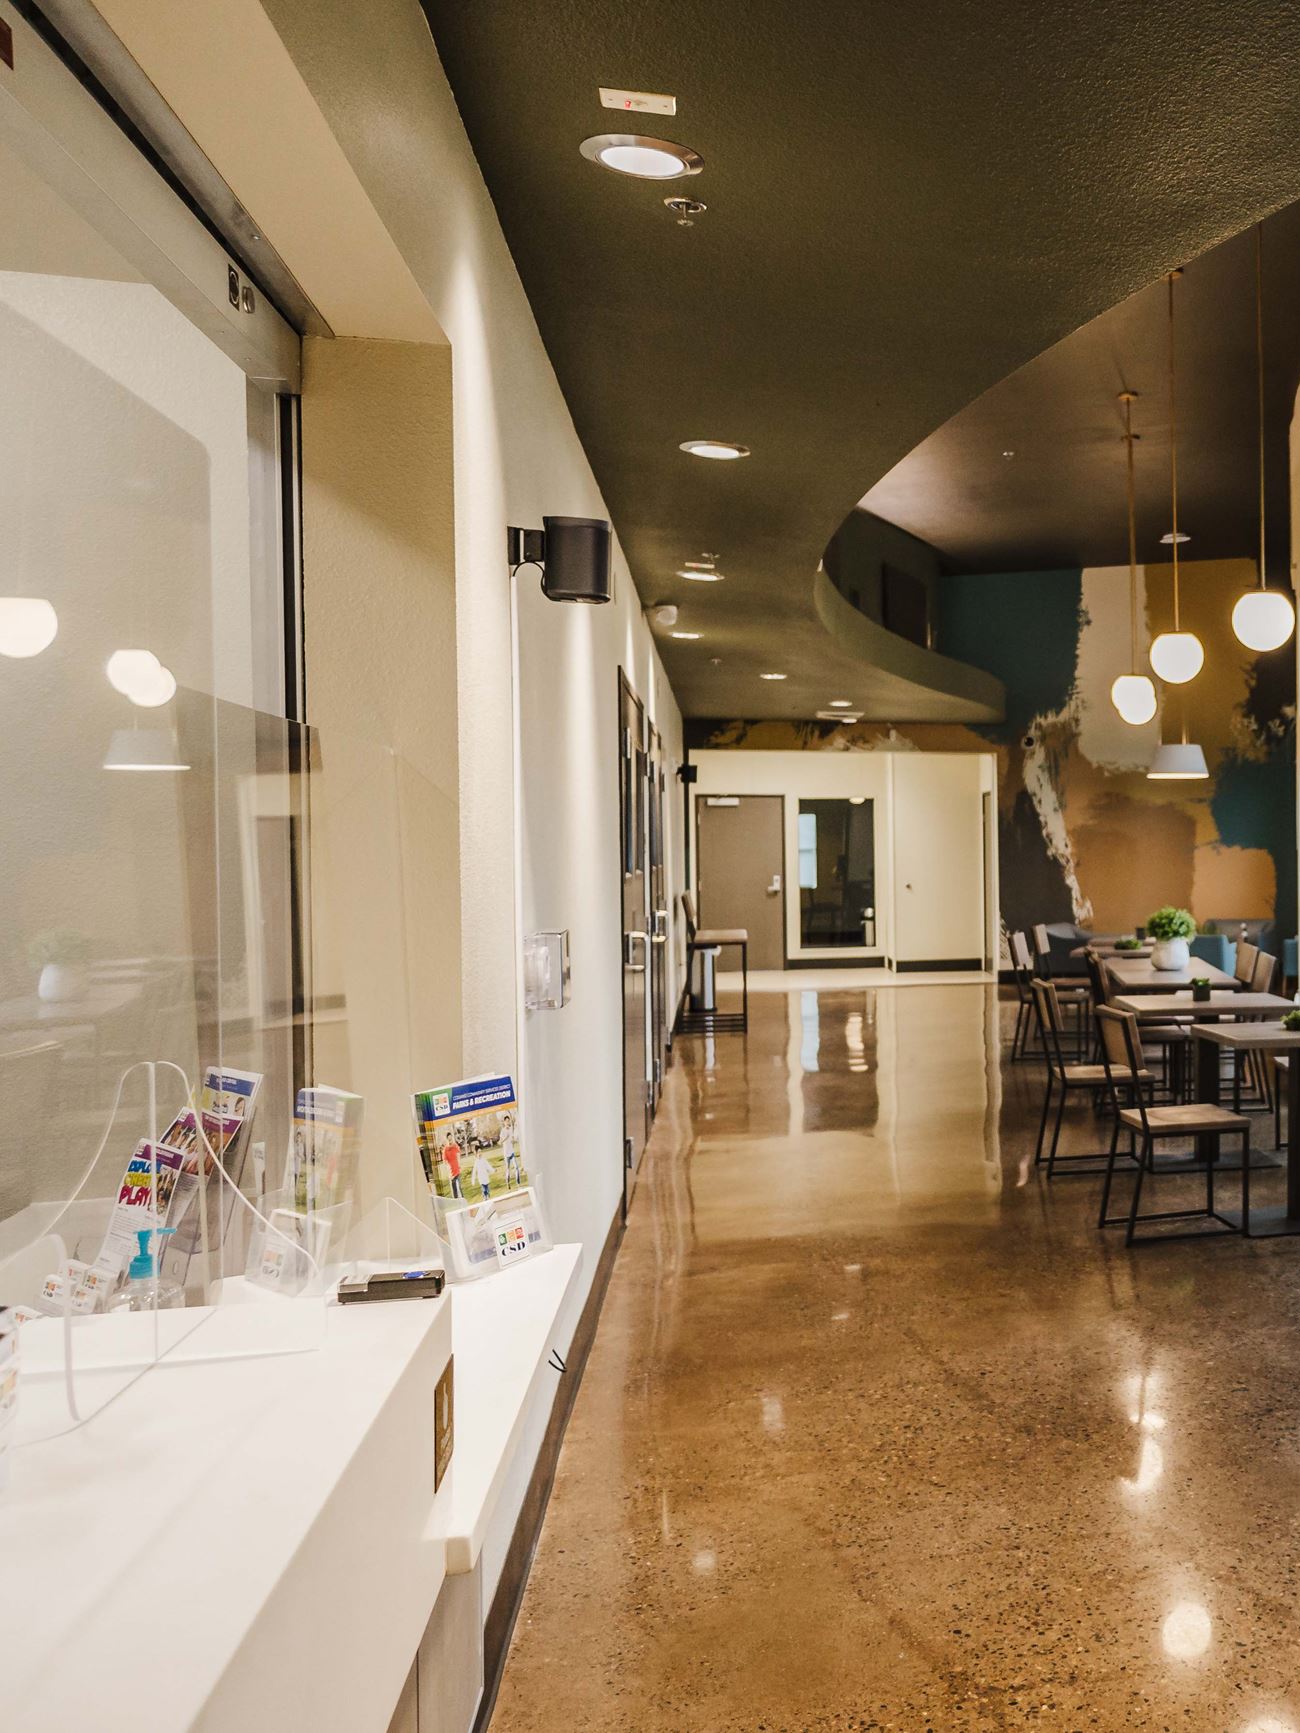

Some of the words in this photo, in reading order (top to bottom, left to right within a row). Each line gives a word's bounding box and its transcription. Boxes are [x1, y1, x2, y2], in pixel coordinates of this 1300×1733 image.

[453, 1099, 469, 1110] PARKS
[470, 1098, 474, 1106] &
[475, 1090, 511, 1105] RECREATION
[501, 1241, 526, 1257] CSD
